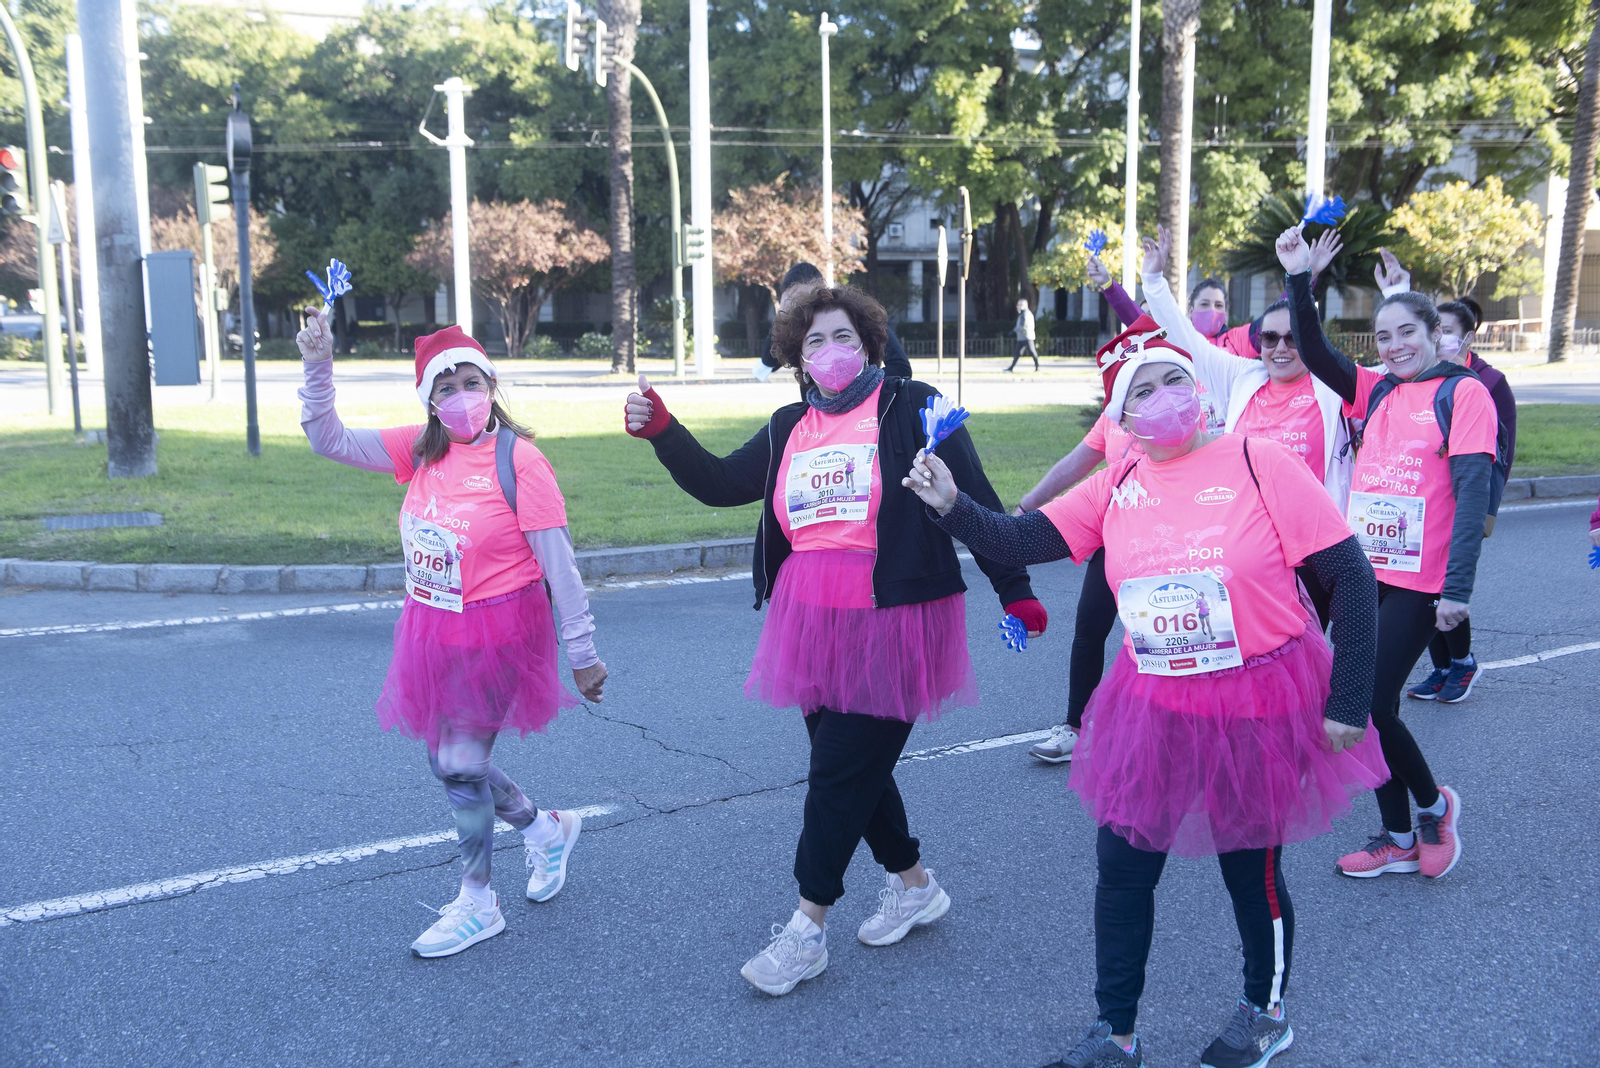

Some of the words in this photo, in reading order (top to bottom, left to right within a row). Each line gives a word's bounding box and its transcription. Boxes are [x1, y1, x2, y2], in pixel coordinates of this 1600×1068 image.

[1283, 432, 1307, 441] POR
[1284, 444, 1307, 452] DAS
[812, 456, 847, 467] ASTURIANA
[1398, 455, 1423, 467] POR
[1384, 465, 1420, 481] TODAS
[811, 470, 844, 490] 016
[1361, 473, 1418, 495] NOSOTRAS
[818, 488, 834, 498] 2010
[1198, 494, 1234, 502] ASTURIANA
[1368, 507, 1398, 516] ASTURIANA
[442, 517, 470, 531] POR
[1366, 522, 1397, 538] 016
[1371, 539, 1388, 547] 2759
[1188, 547, 1224, 560] POR
[413, 550, 444, 572] 016
[417, 569, 432, 580] 1310
[1152, 593, 1195, 604] ASTURIANA
[1153, 613, 1198, 634] 016
[1165, 636, 1189, 646] 2205
[1194, 643, 1217, 651] MUJER
